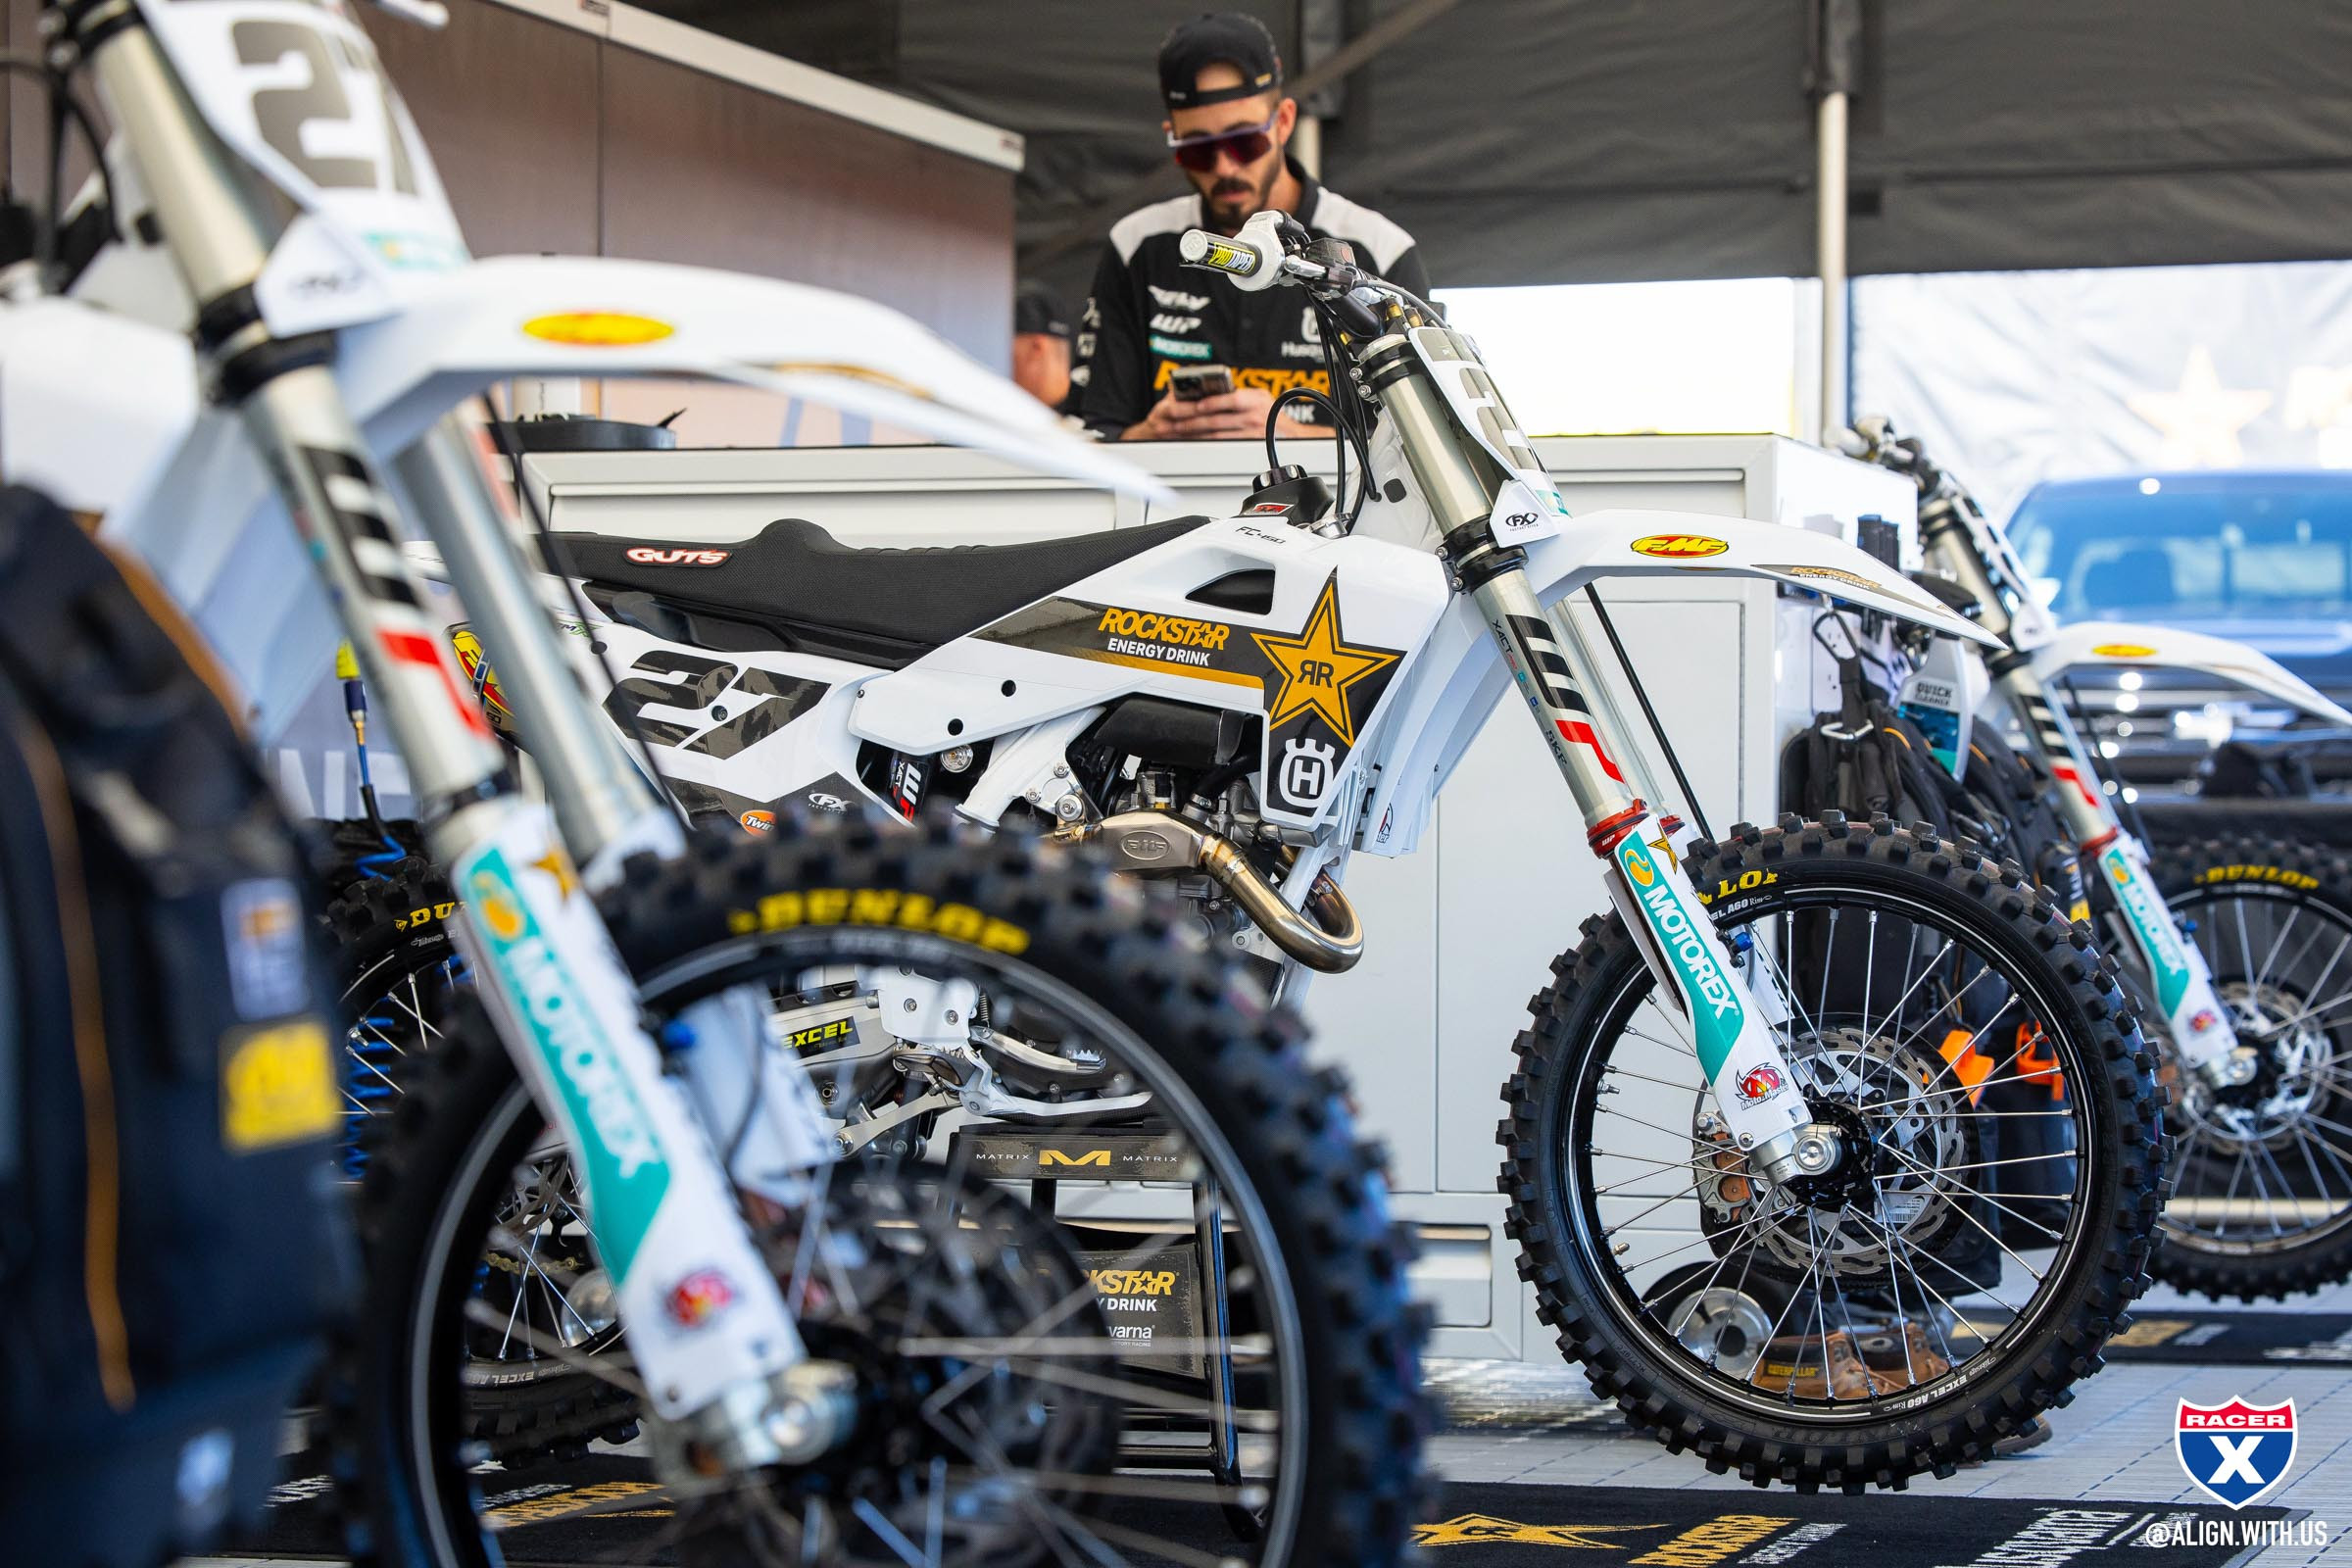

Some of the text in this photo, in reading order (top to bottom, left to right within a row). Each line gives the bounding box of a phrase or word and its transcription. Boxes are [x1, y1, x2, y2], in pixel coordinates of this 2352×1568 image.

[1632, 537, 1728, 553] FMF
[626, 547, 731, 565] GUTS
[1098, 608, 1230, 651] ROCKSTAR
[1107, 638, 1210, 666] ENERGY DRINK
[1728, 899, 1748, 913] A60
[1643, 884, 1739, 1020] MOTOREX
[784, 1020, 854, 1049] EXCEL
[1106, 1298, 1157, 1311] DRINK
[1109, 1325, 1152, 1339] varna
[1931, 1374, 1968, 1396] EXCEL
[1907, 1395, 1929, 1408] A60
